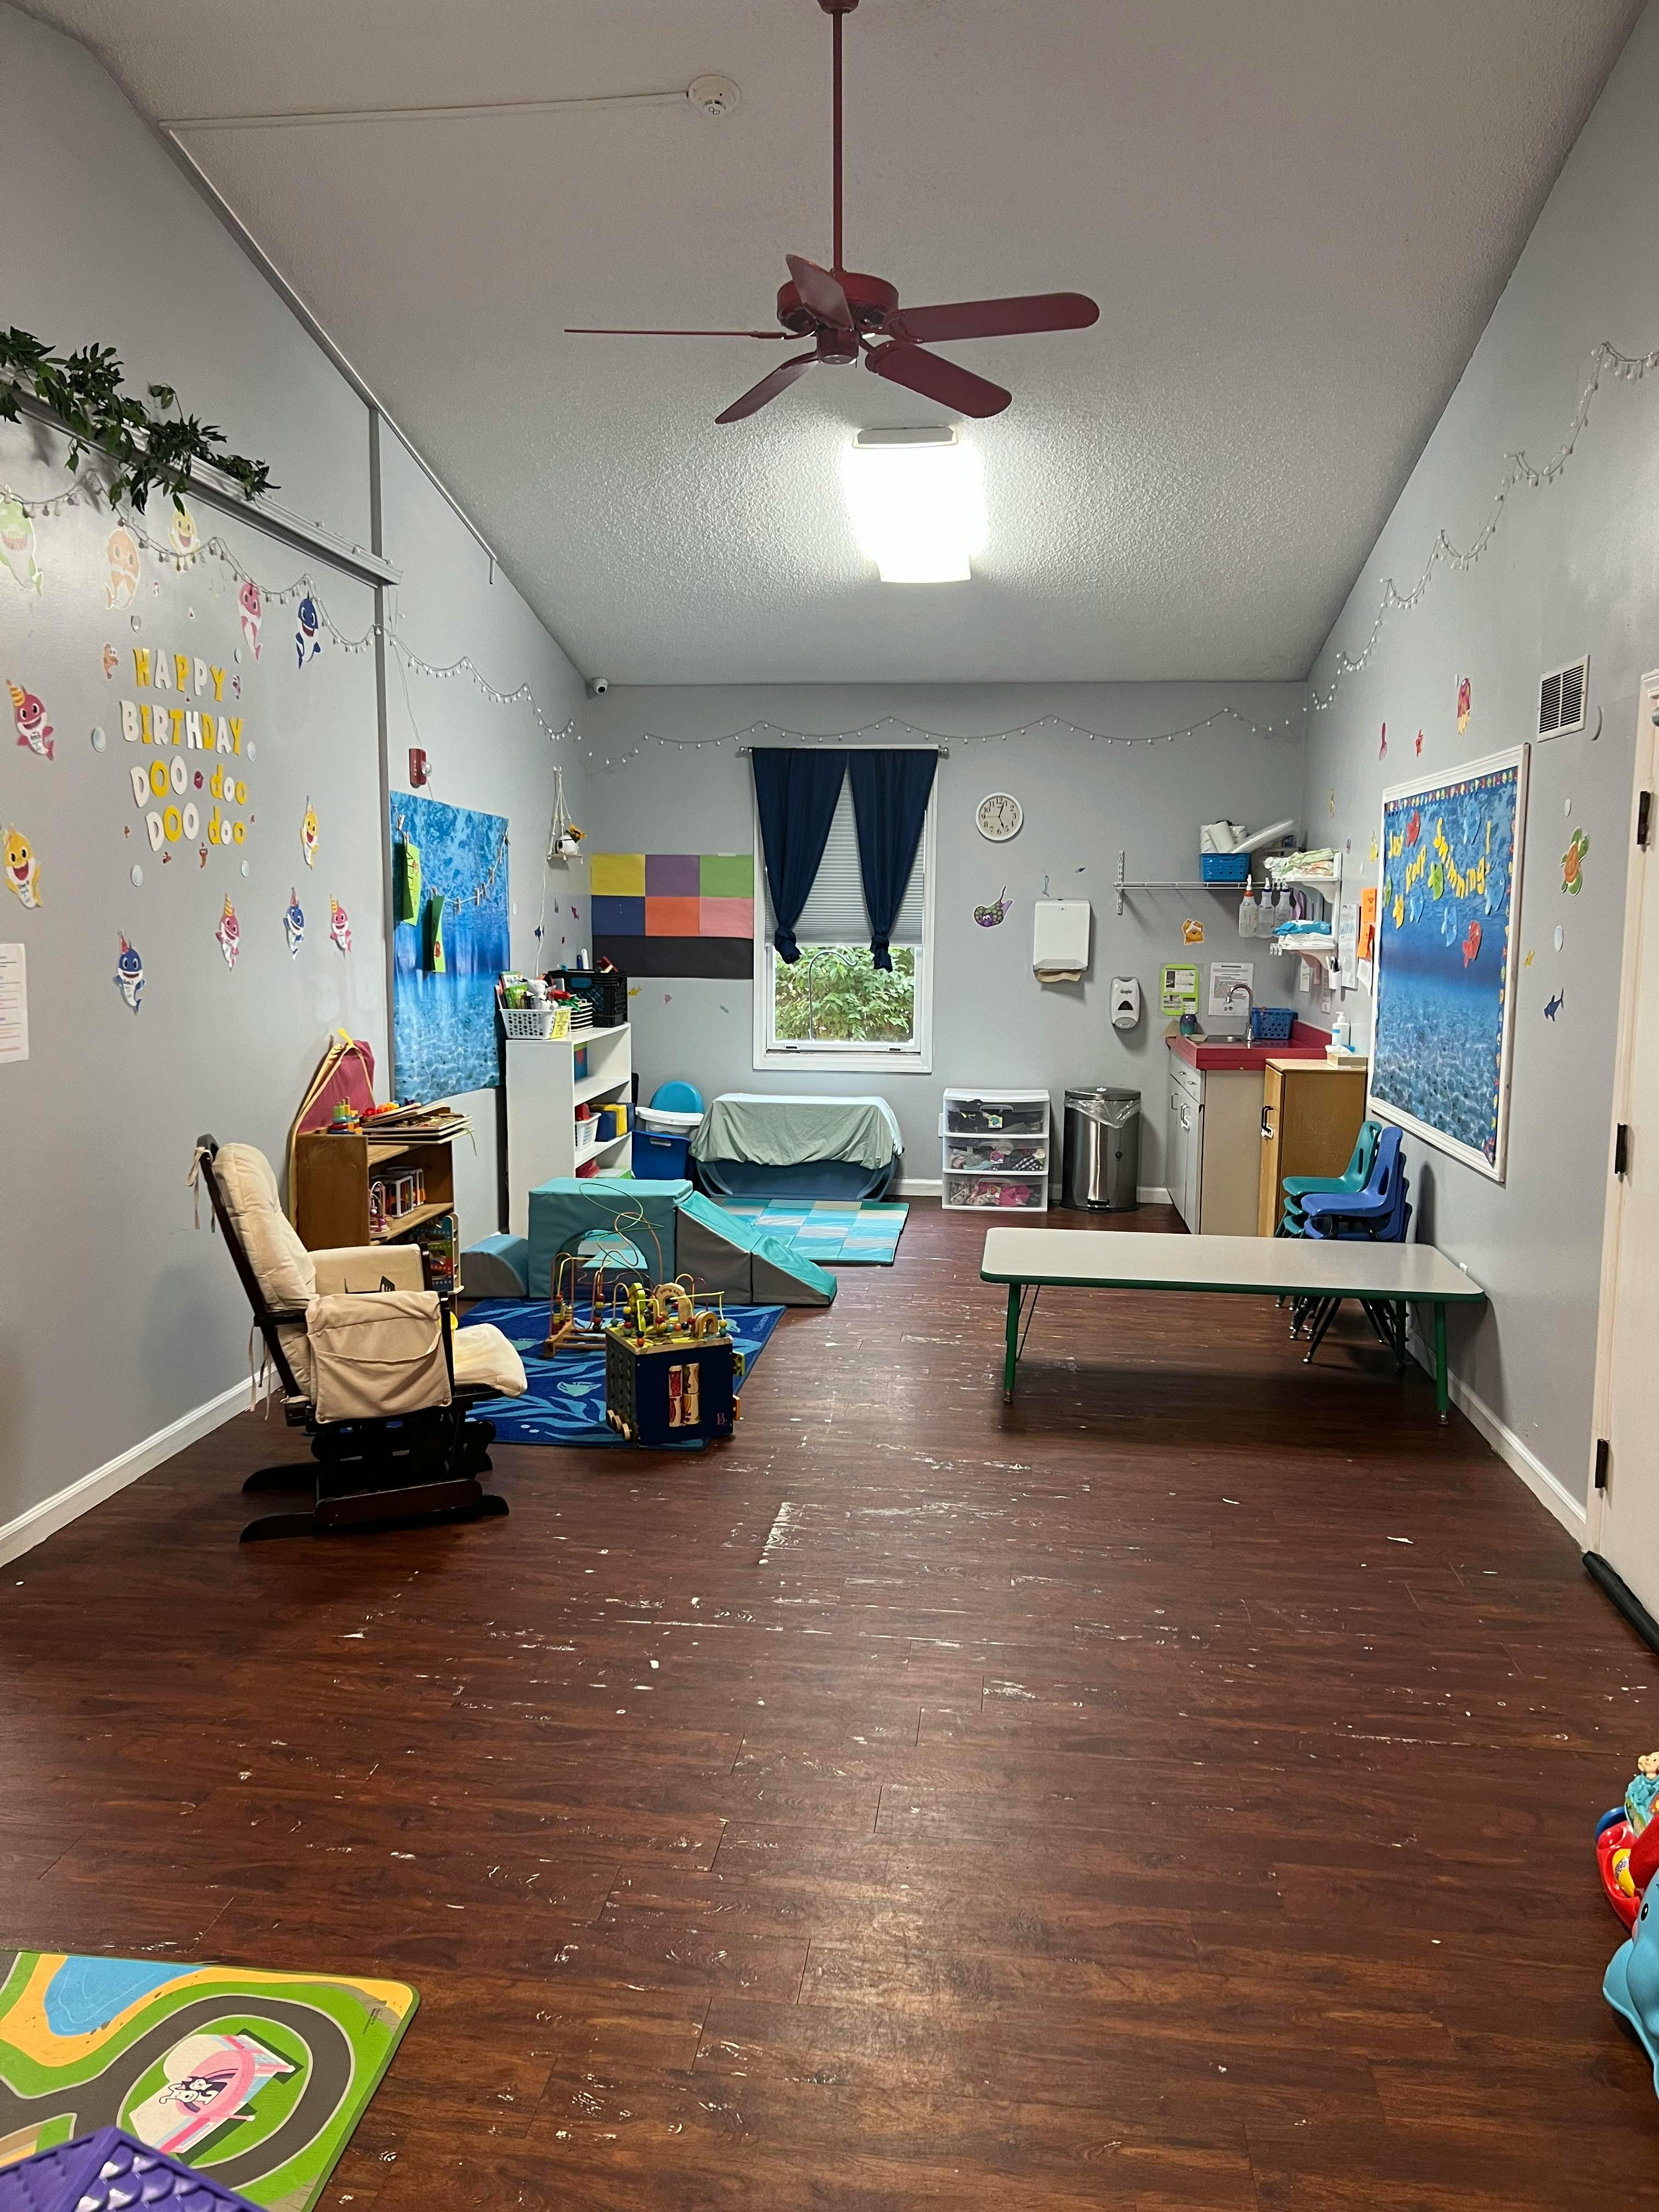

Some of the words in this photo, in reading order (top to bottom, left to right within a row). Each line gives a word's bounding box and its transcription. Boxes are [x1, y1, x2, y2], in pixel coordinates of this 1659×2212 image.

[133, 648, 227, 702] HAPPY
[120, 700, 244, 756] BIRTHDAY
[129, 755, 188, 808] DOO
[210, 763, 248, 805] doo
[145, 802, 200, 852] DOO
[208, 805, 246, 845] doo
[1388, 829, 1404, 860] Just
